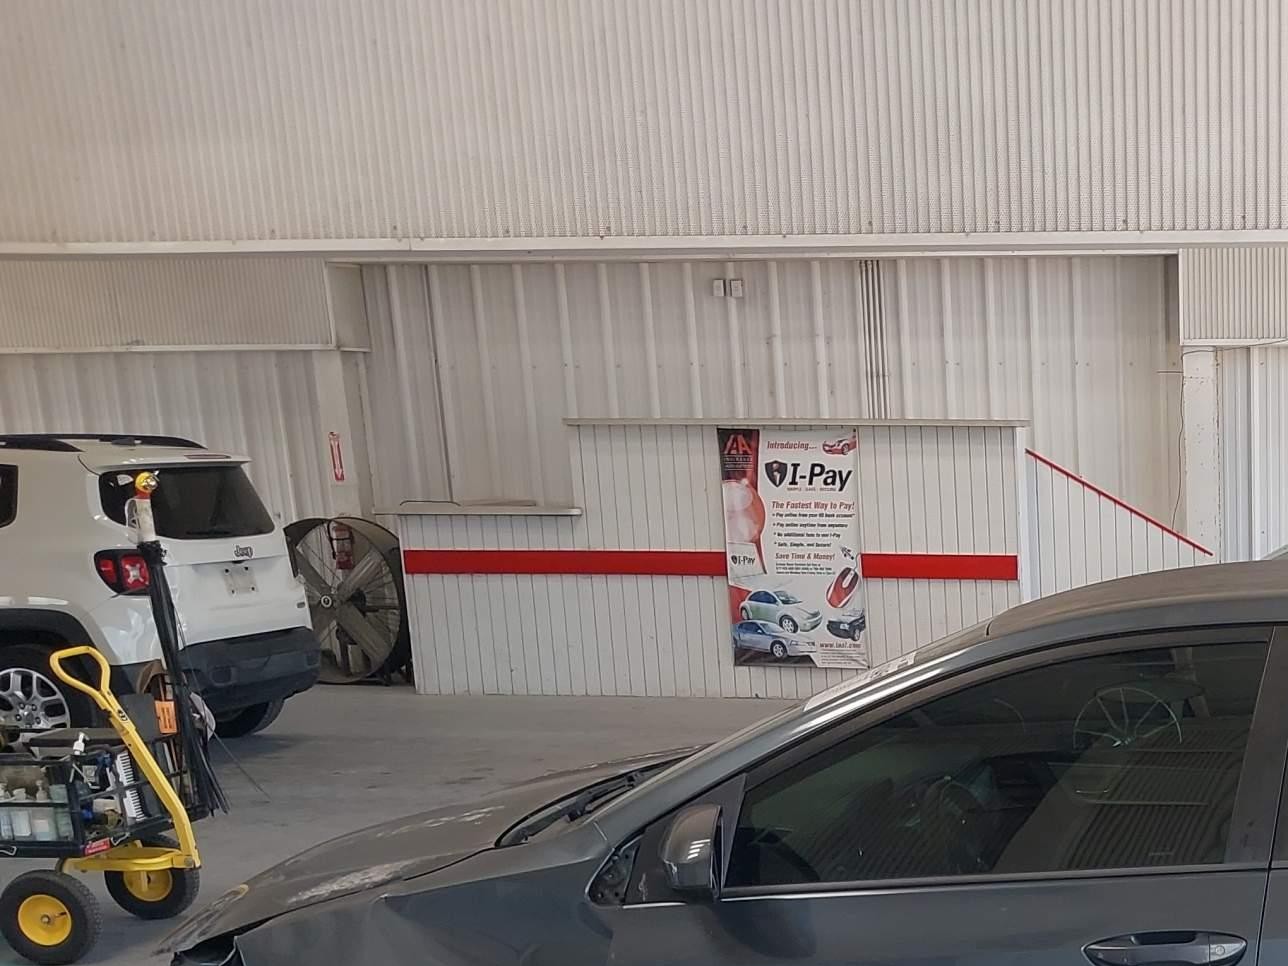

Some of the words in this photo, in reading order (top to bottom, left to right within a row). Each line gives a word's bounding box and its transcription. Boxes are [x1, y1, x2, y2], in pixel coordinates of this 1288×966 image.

[788, 462, 853, 492] I-Pay
[772, 501, 785, 509] The
[786, 501, 812, 509] Fastest
[814, 502, 829, 510] Way
[839, 502, 855, 511] Pay!
[738, 555, 756, 566] I-Pay
[813, 553, 836, 561] Money!
